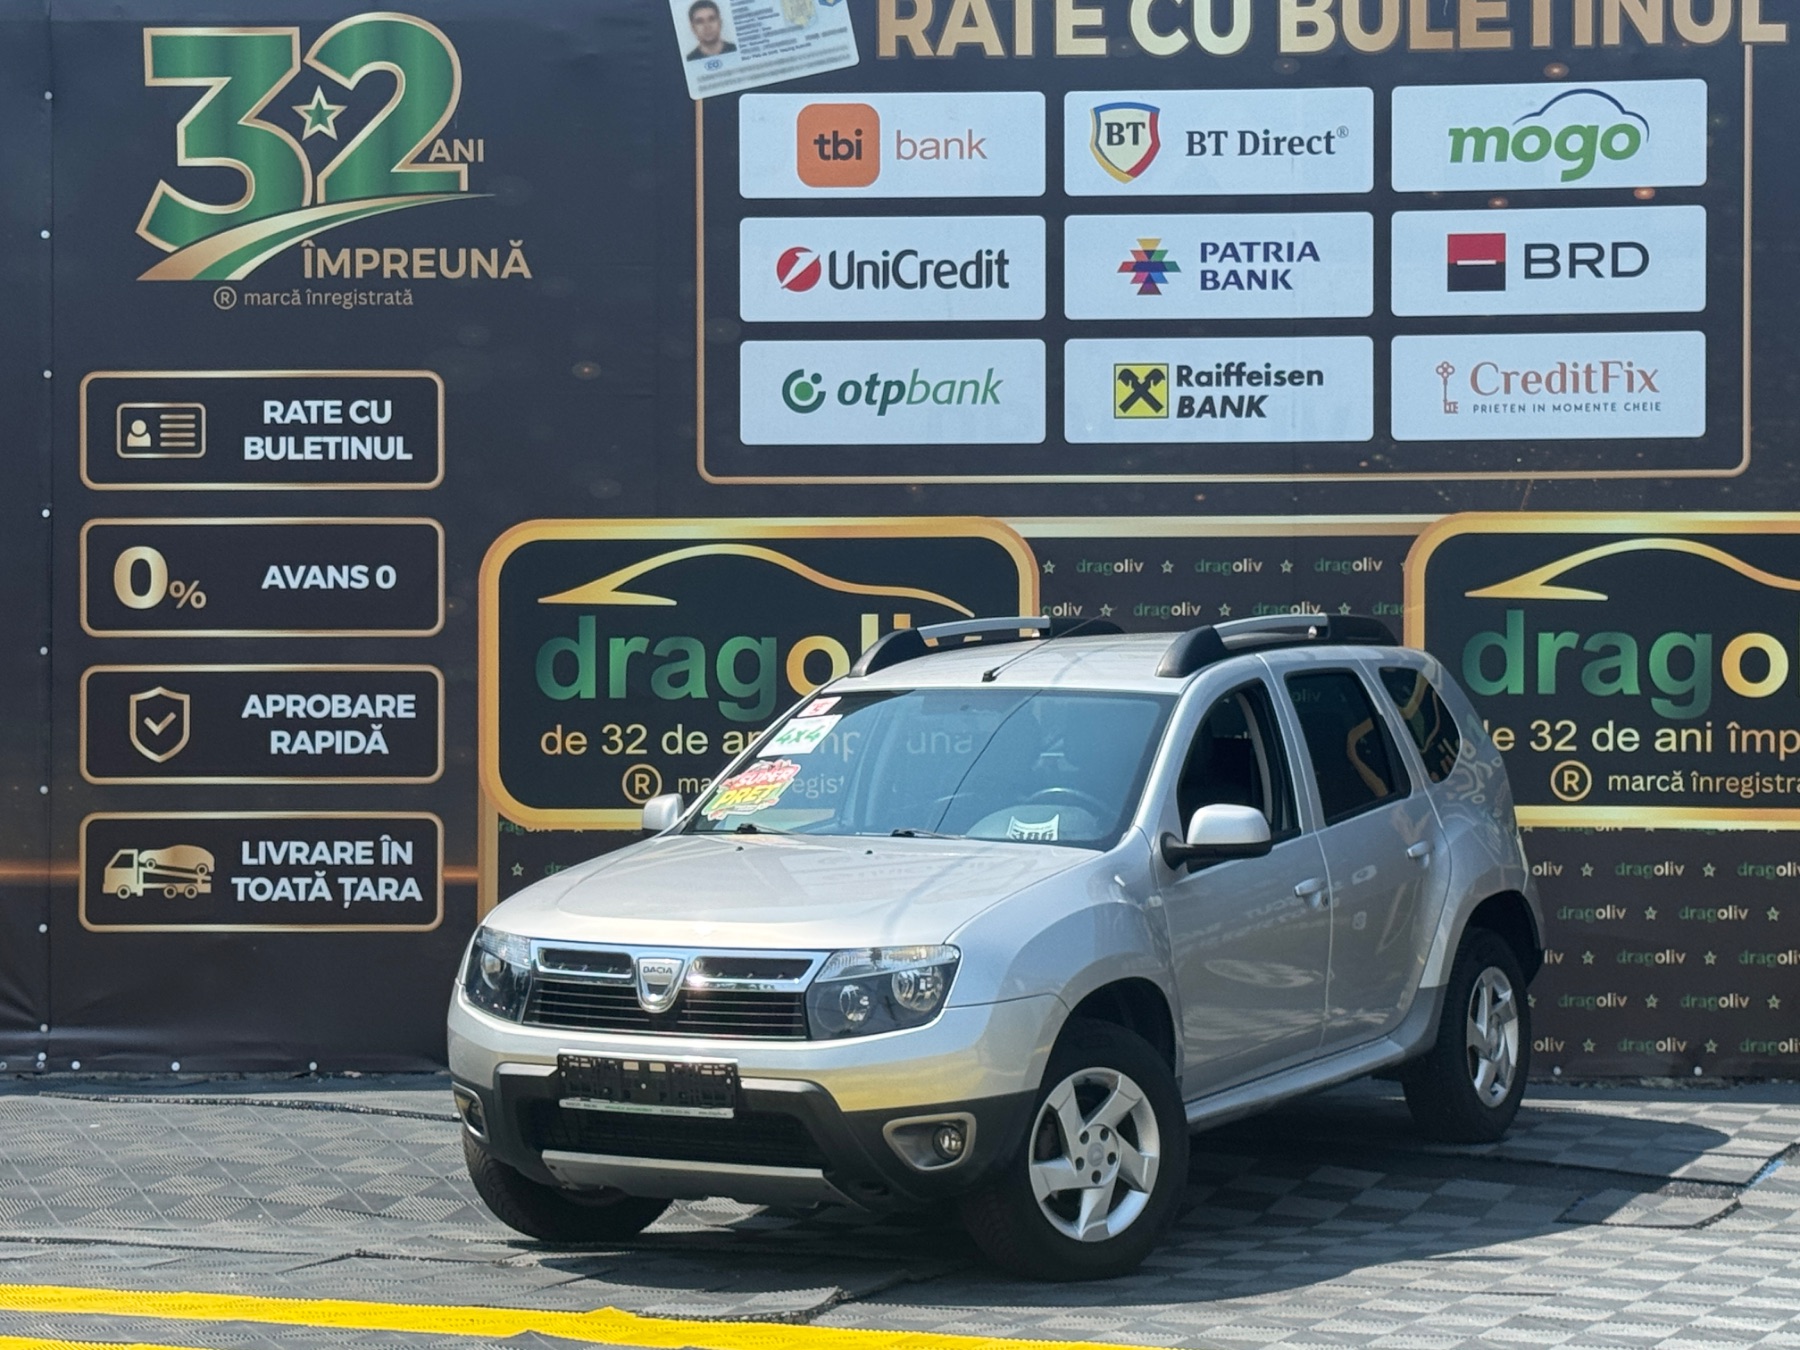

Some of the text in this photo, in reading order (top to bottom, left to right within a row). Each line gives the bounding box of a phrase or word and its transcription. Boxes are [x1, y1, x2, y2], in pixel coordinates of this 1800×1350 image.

[1129, 0, 1253, 57] CU
[135, 11, 469, 254] 32
[813, 129, 988, 161] tbi bank
[1106, 121, 1146, 147] BT
[1185, 131, 1228, 157] BT
[428, 138, 485, 163] ANI
[1448, 123, 1641, 182] mogo
[302, 240, 533, 280] ÎMPREUNĂ
[1200, 241, 1320, 263] PATRIA
[1523, 242, 1650, 279] BRD
[828, 249, 1010, 290] UniCredit
[1200, 269, 1293, 290] BANK
[244, 288, 301, 307] marcă
[306, 287, 413, 309] înregistrată
[1176, 362, 1324, 388] Raiffeisen
[1470, 360, 1660, 396] CreditFix
[837, 368, 1003, 416] otpbank
[263, 400, 392, 424] RATE CU
[1176, 395, 1268, 419] BANK
[1473, 402, 1662, 414] PRIETEN IN MOMENTE CHEIE
[244, 436, 413, 461] BULETINUL
[262, 565, 397, 589] AVANS 0
[1076, 557, 1383, 575] dragoliv dragoliv dragoliv
[1133, 602, 1201, 618] dragoliv
[1462, 609, 1800, 719] drago
[241, 694, 416, 718] APROBARE
[270, 723, 389, 754] RAPIDĂ
[541, 724, 587, 755] de
[602, 724, 647, 755] 32
[661, 724, 708, 755] de
[1530, 720, 1577, 751] 32
[1592, 720, 1640, 751] de
[1654, 722, 1713, 753] ani
[1608, 771, 1684, 792] marcă
[241, 835, 413, 865] LIVRARE ÎN
[1615, 861, 1685, 879] dragoliv
[231, 870, 423, 908] TOATĂ ȚARA
[1557, 904, 1749, 923] dragoliv dragoliv
[643, 966, 673, 975] DACIA
[1616, 949, 1686, 968] dragoliv
[1558, 992, 1750, 1010] dragoliv dragoliv
[1617, 1036, 1688, 1055] dragoliv
